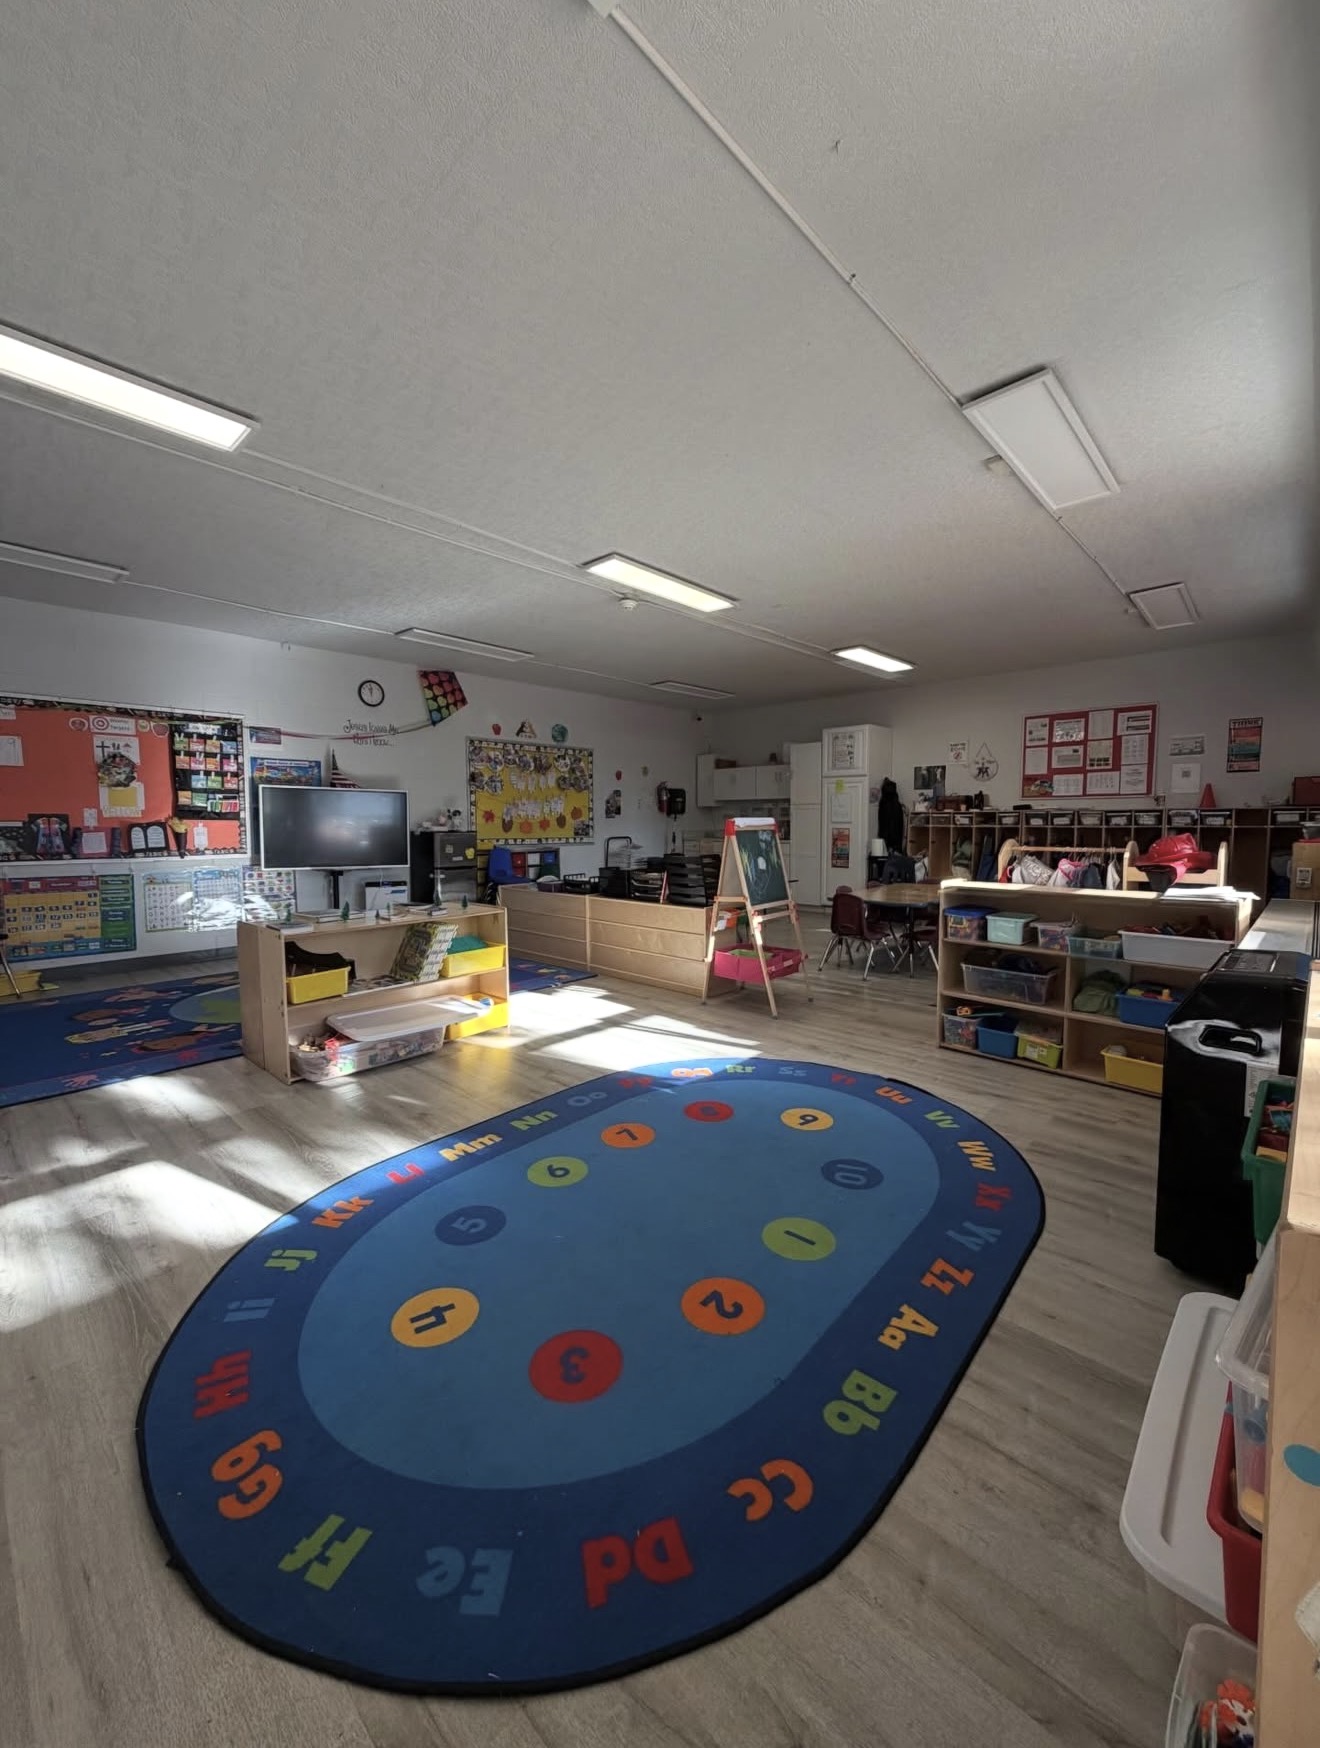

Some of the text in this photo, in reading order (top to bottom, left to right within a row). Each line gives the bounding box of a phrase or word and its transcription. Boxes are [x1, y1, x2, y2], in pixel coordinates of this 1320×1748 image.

[726, 1064, 755, 1074] Rr
[566, 1091, 608, 1107] Oo
[875, 1086, 912, 1104] Uu
[510, 1110, 558, 1131] Nn
[798, 1114, 819, 1126] 9
[923, 1110, 960, 1128] Vv
[438, 1133, 502, 1162] Mm
[615, 1128, 638, 1141] 7
[957, 1141, 996, 1171] Ww
[386, 1163, 426, 1184] Ll
[546, 1164, 571, 1178] 6
[836, 1163, 868, 1186] 10
[975, 1183, 1011, 1211] Xx
[312, 1196, 374, 1228] Kk
[451, 1216, 487, 1233] 5
[783, 1230, 817, 1246] 1
[945, 1221, 1002, 1251] Yy
[264, 1249, 317, 1271] Jj
[921, 1258, 974, 1295] Zz
[223, 1298, 275, 1322] Ii
[409, 1303, 456, 1335] 4
[699, 1290, 744, 1319] 2
[878, 1304, 939, 1350] Aa
[560, 1346, 590, 1385] 3
[193, 1350, 251, 1420] Hh
[823, 1370, 898, 1436] Bb
[211, 1430, 283, 1519] Gg
[727, 1459, 814, 1521] Cc
[278, 1514, 373, 1591] Ff
[582, 1517, 694, 1609] Dd
[415, 1545, 513, 1617] Ee
